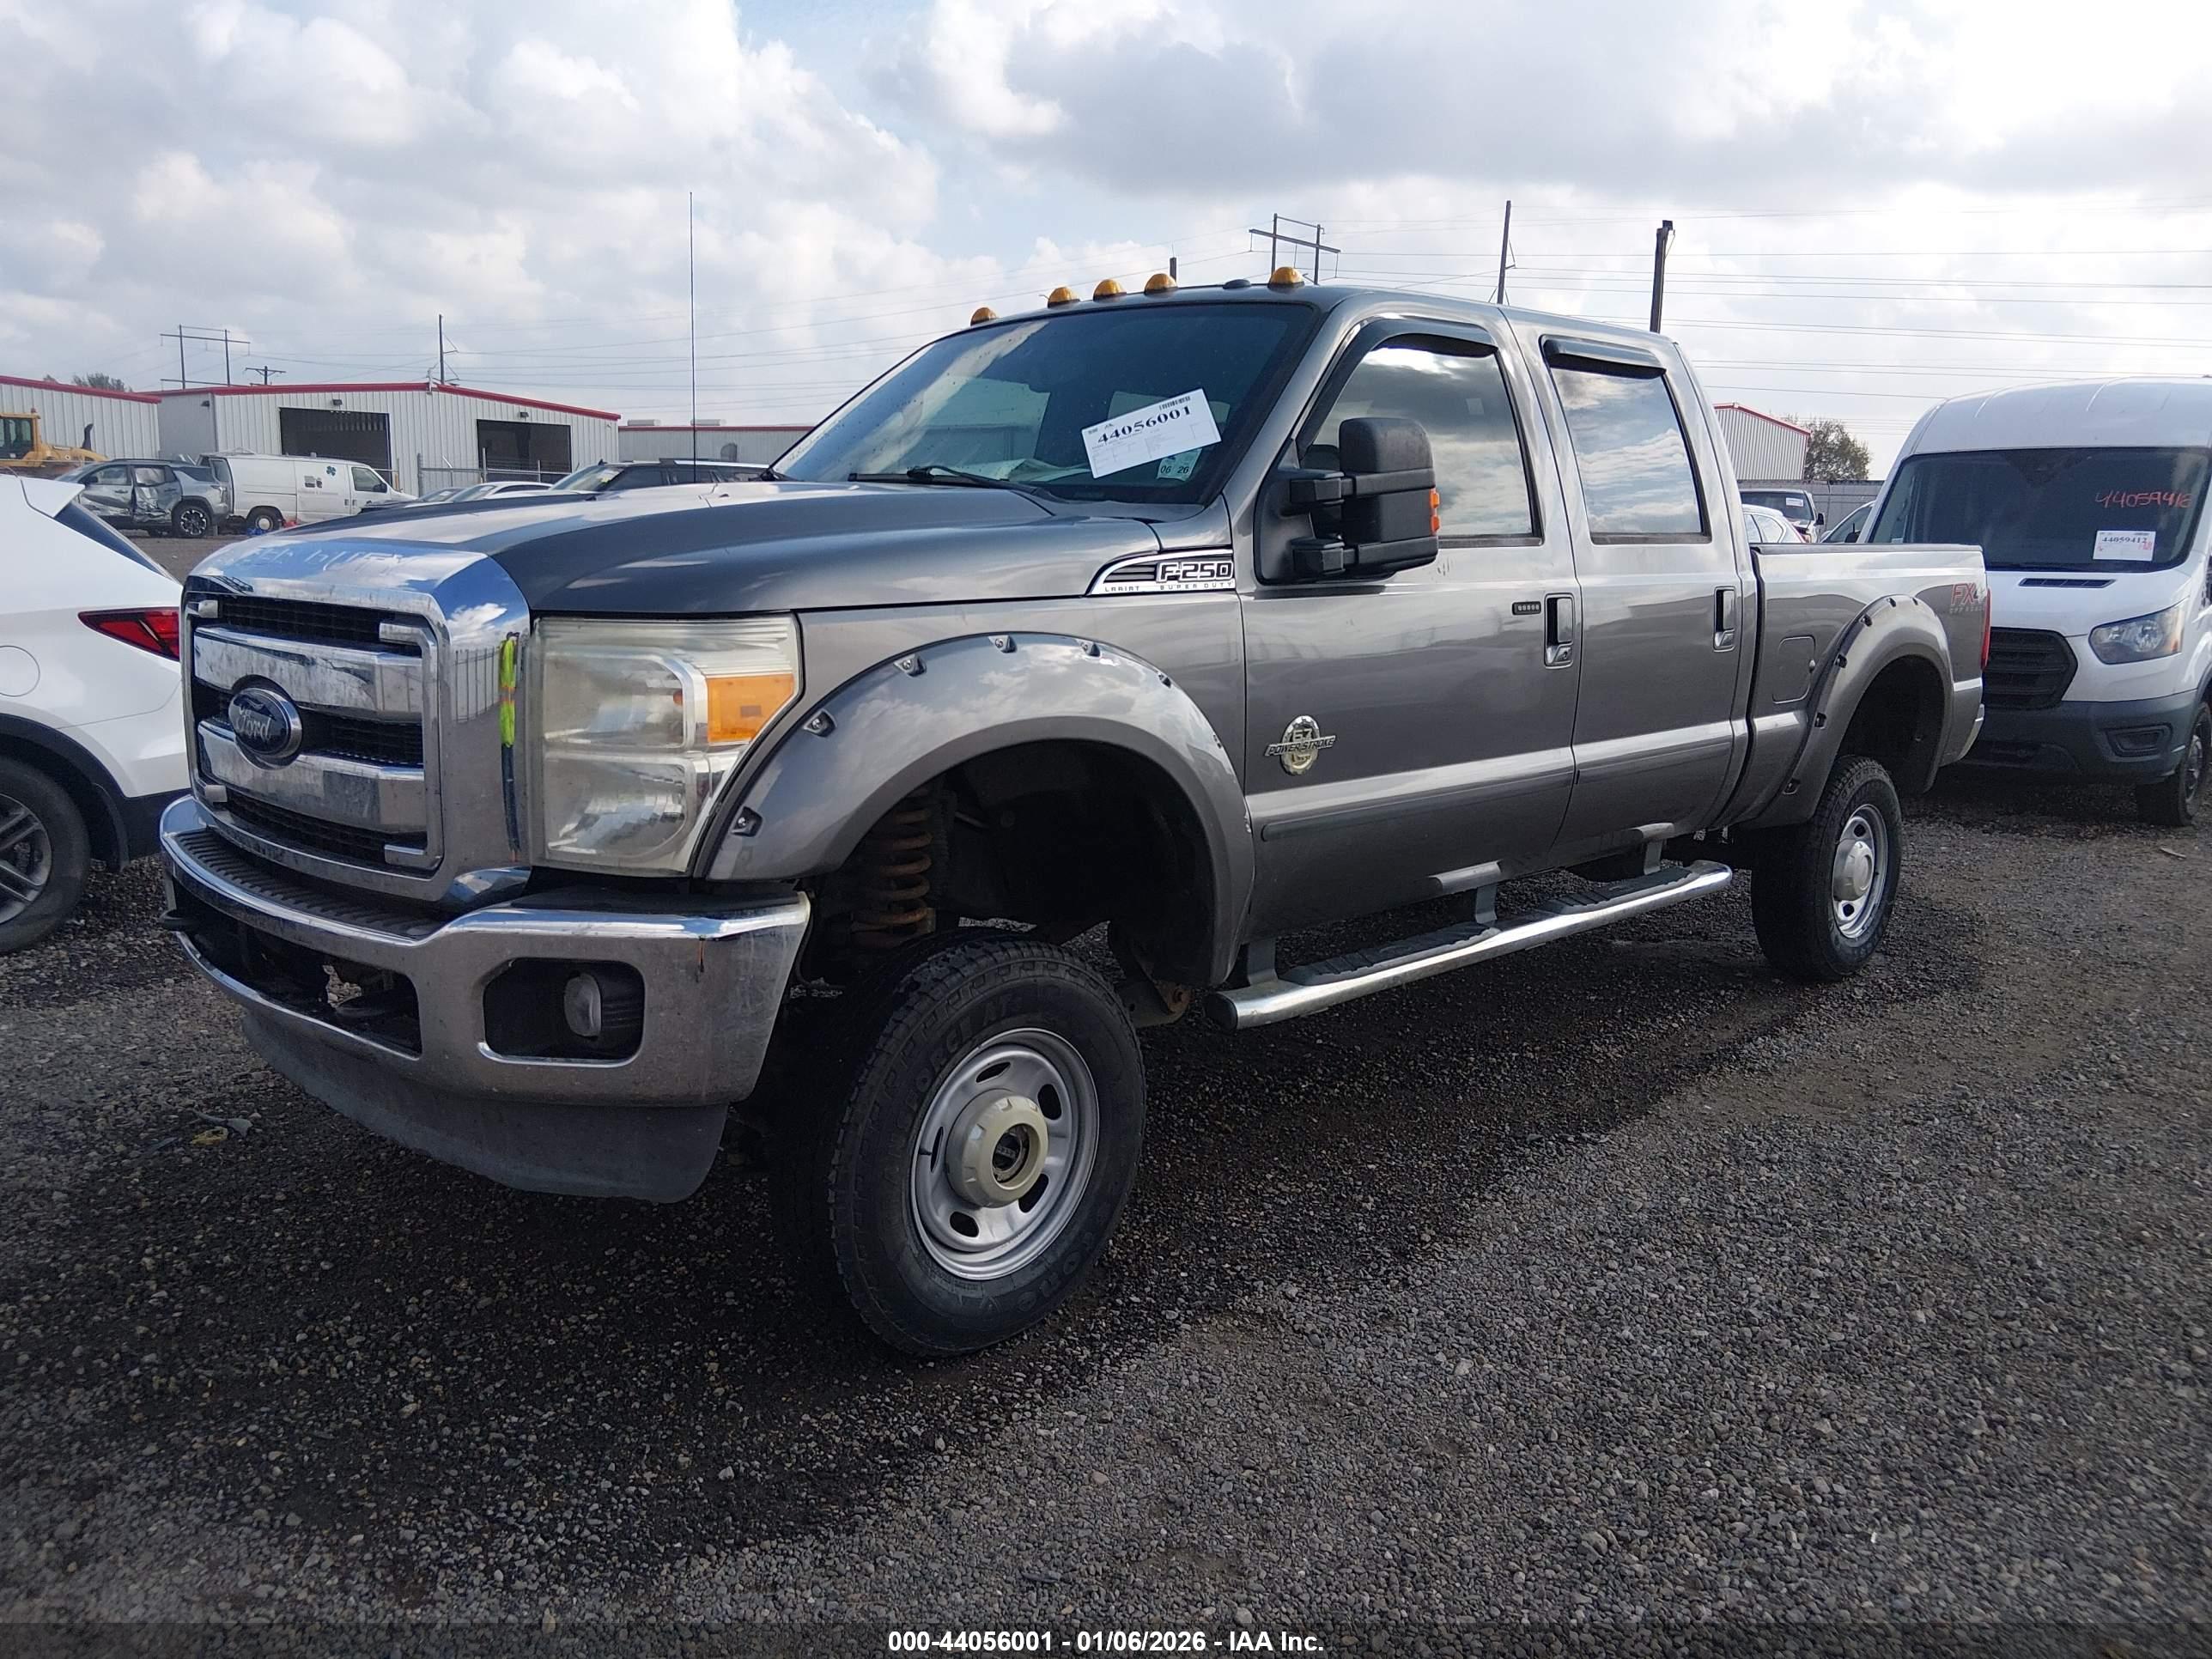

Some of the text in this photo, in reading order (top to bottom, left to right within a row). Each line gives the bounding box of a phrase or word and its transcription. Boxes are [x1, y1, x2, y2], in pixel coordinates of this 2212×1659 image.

[1097, 405, 1192, 444] 44056001
[1160, 465, 1190, 474] 06 26
[1158, 562, 1234, 583] F-250
